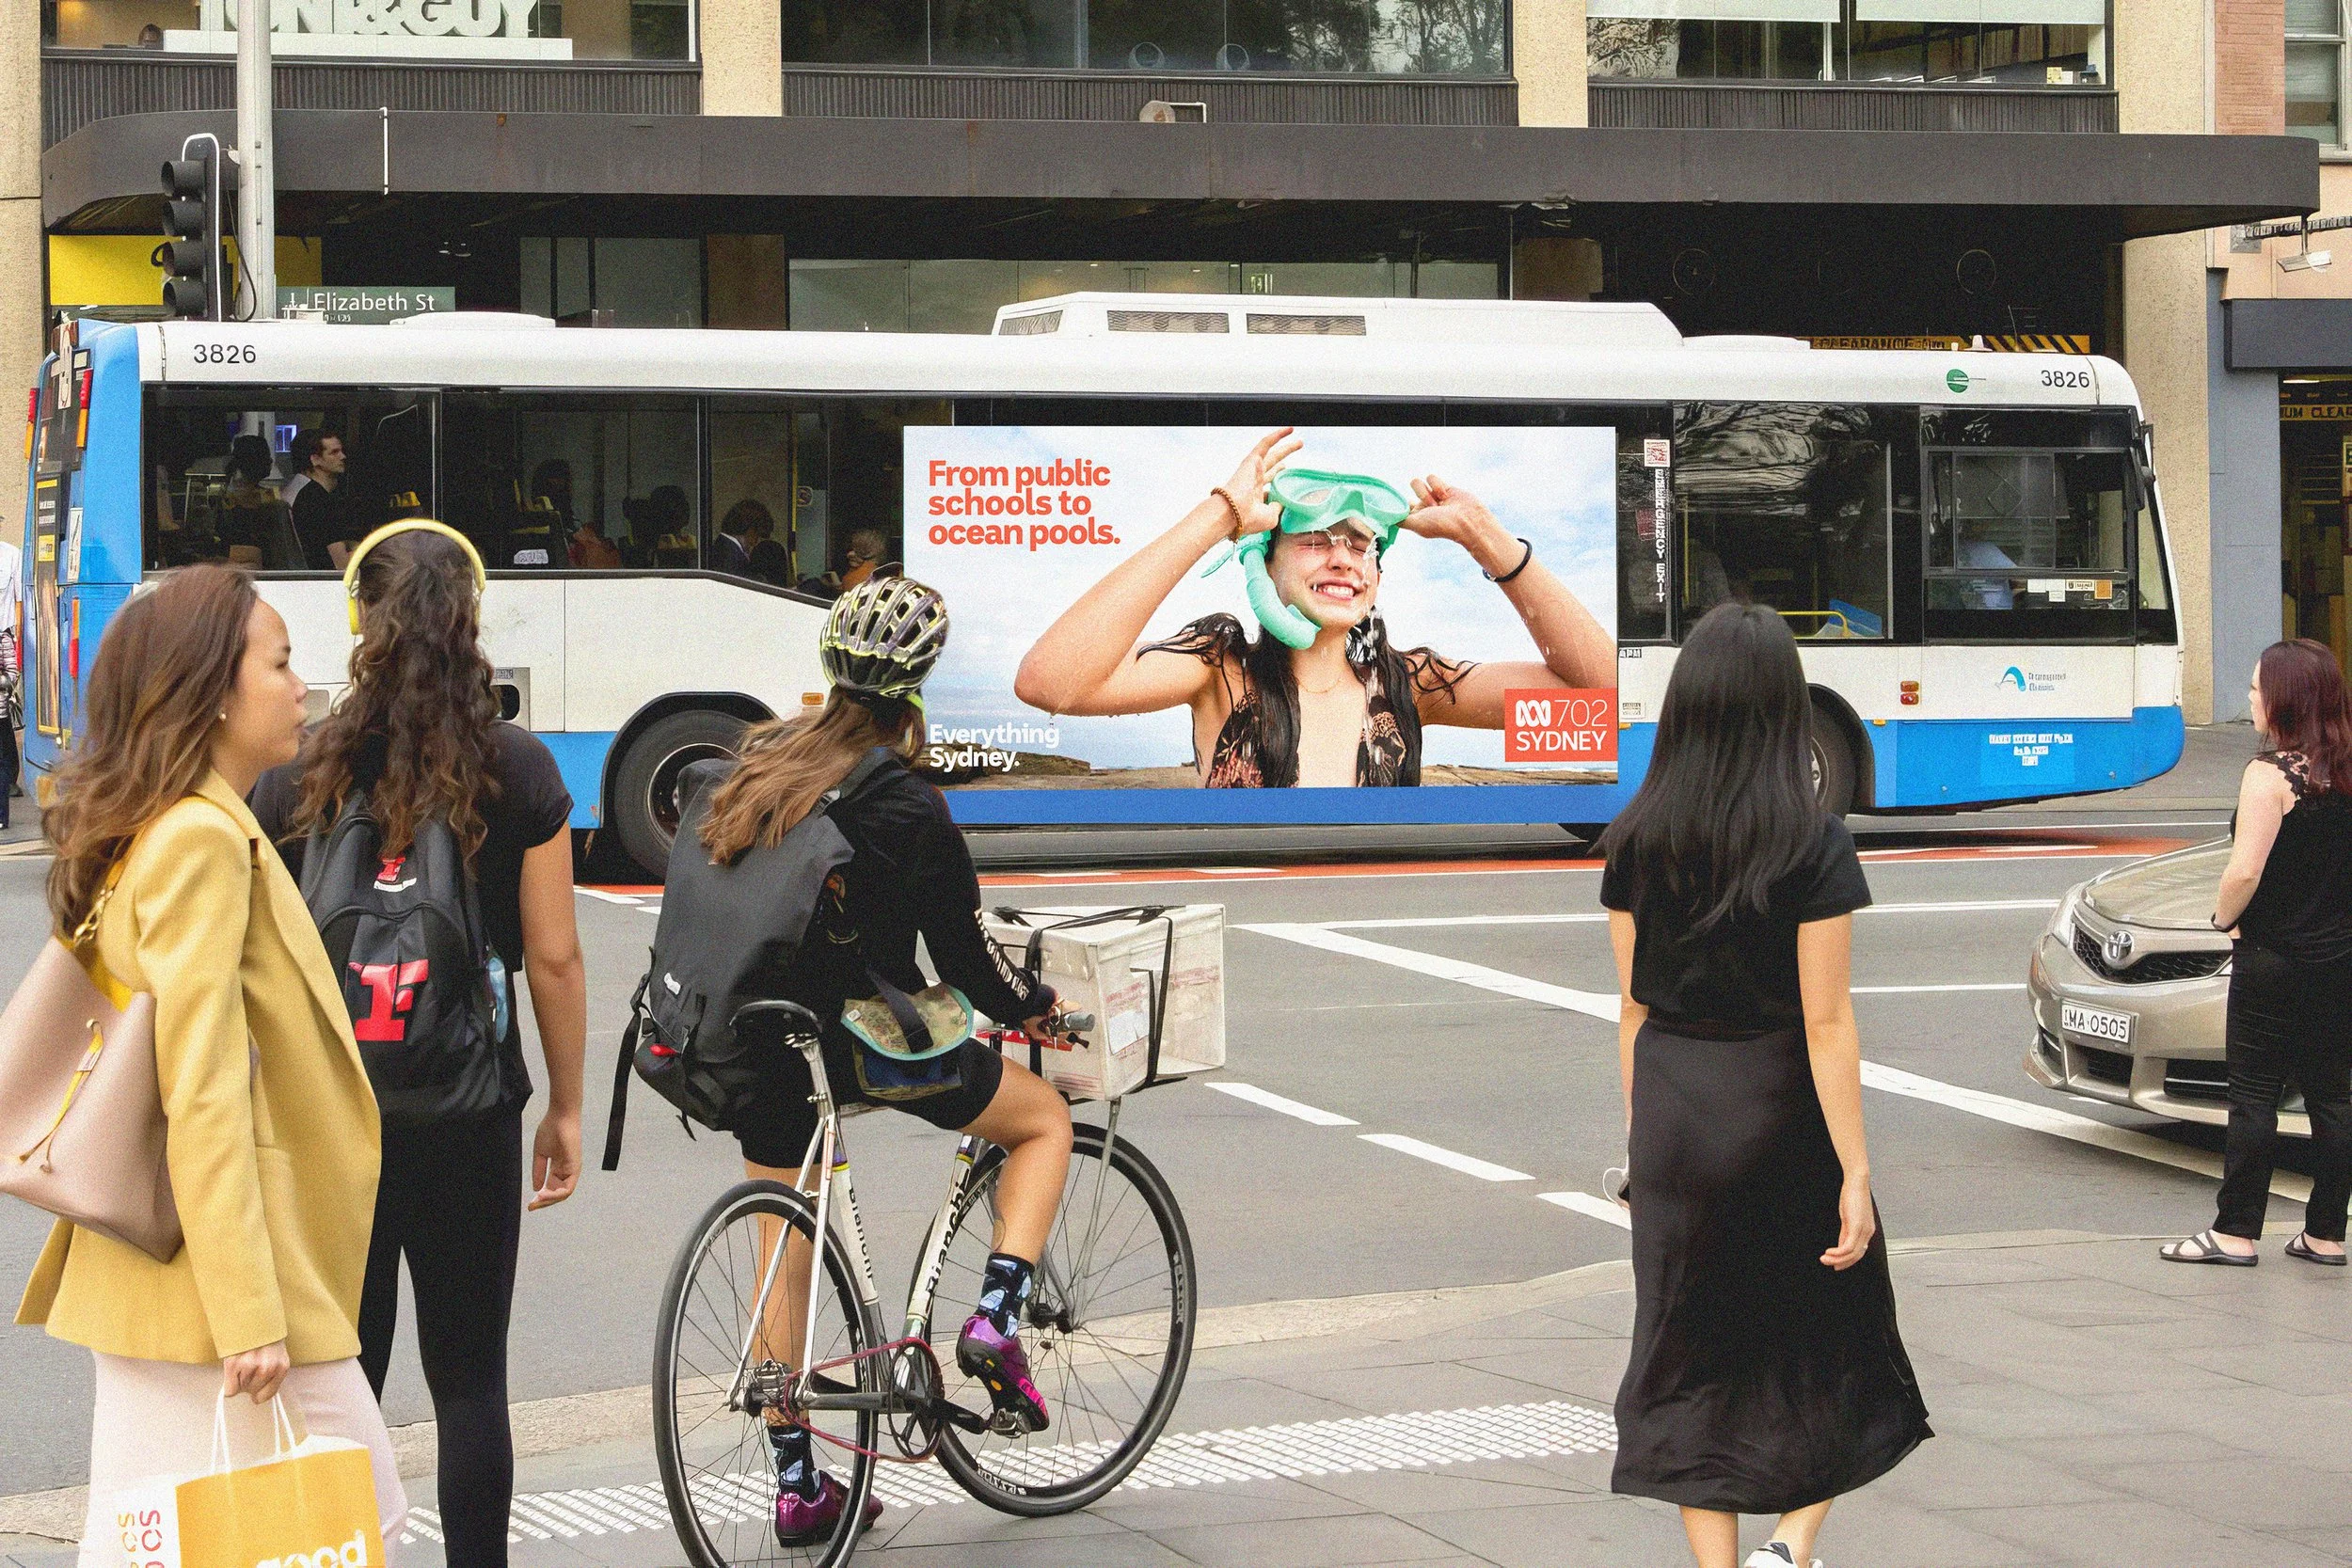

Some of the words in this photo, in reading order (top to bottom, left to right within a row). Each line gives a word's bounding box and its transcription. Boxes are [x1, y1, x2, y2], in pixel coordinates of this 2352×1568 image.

[199, 0, 535, 39] NI&GUY
[314, 293, 407, 311] Elizabeth
[416, 293, 436, 311] St
[193, 343, 257, 364] 3826
[2041, 370, 2090, 388] 3826
[929, 459, 1009, 487] From
[1015, 457, 1111, 494] public
[928, 487, 1053, 516] schools
[1057, 490, 1092, 515] to
[928, 523, 1024, 546] ocean
[1029, 515, 1121, 552] pools.
[1656, 562, 1666, 603] EXIT
[1553, 699, 1608, 727] 702
[930, 721, 1060, 750] Everything
[1515, 730, 1608, 752] SYDNEY
[929, 745, 1021, 773] Sydney.
